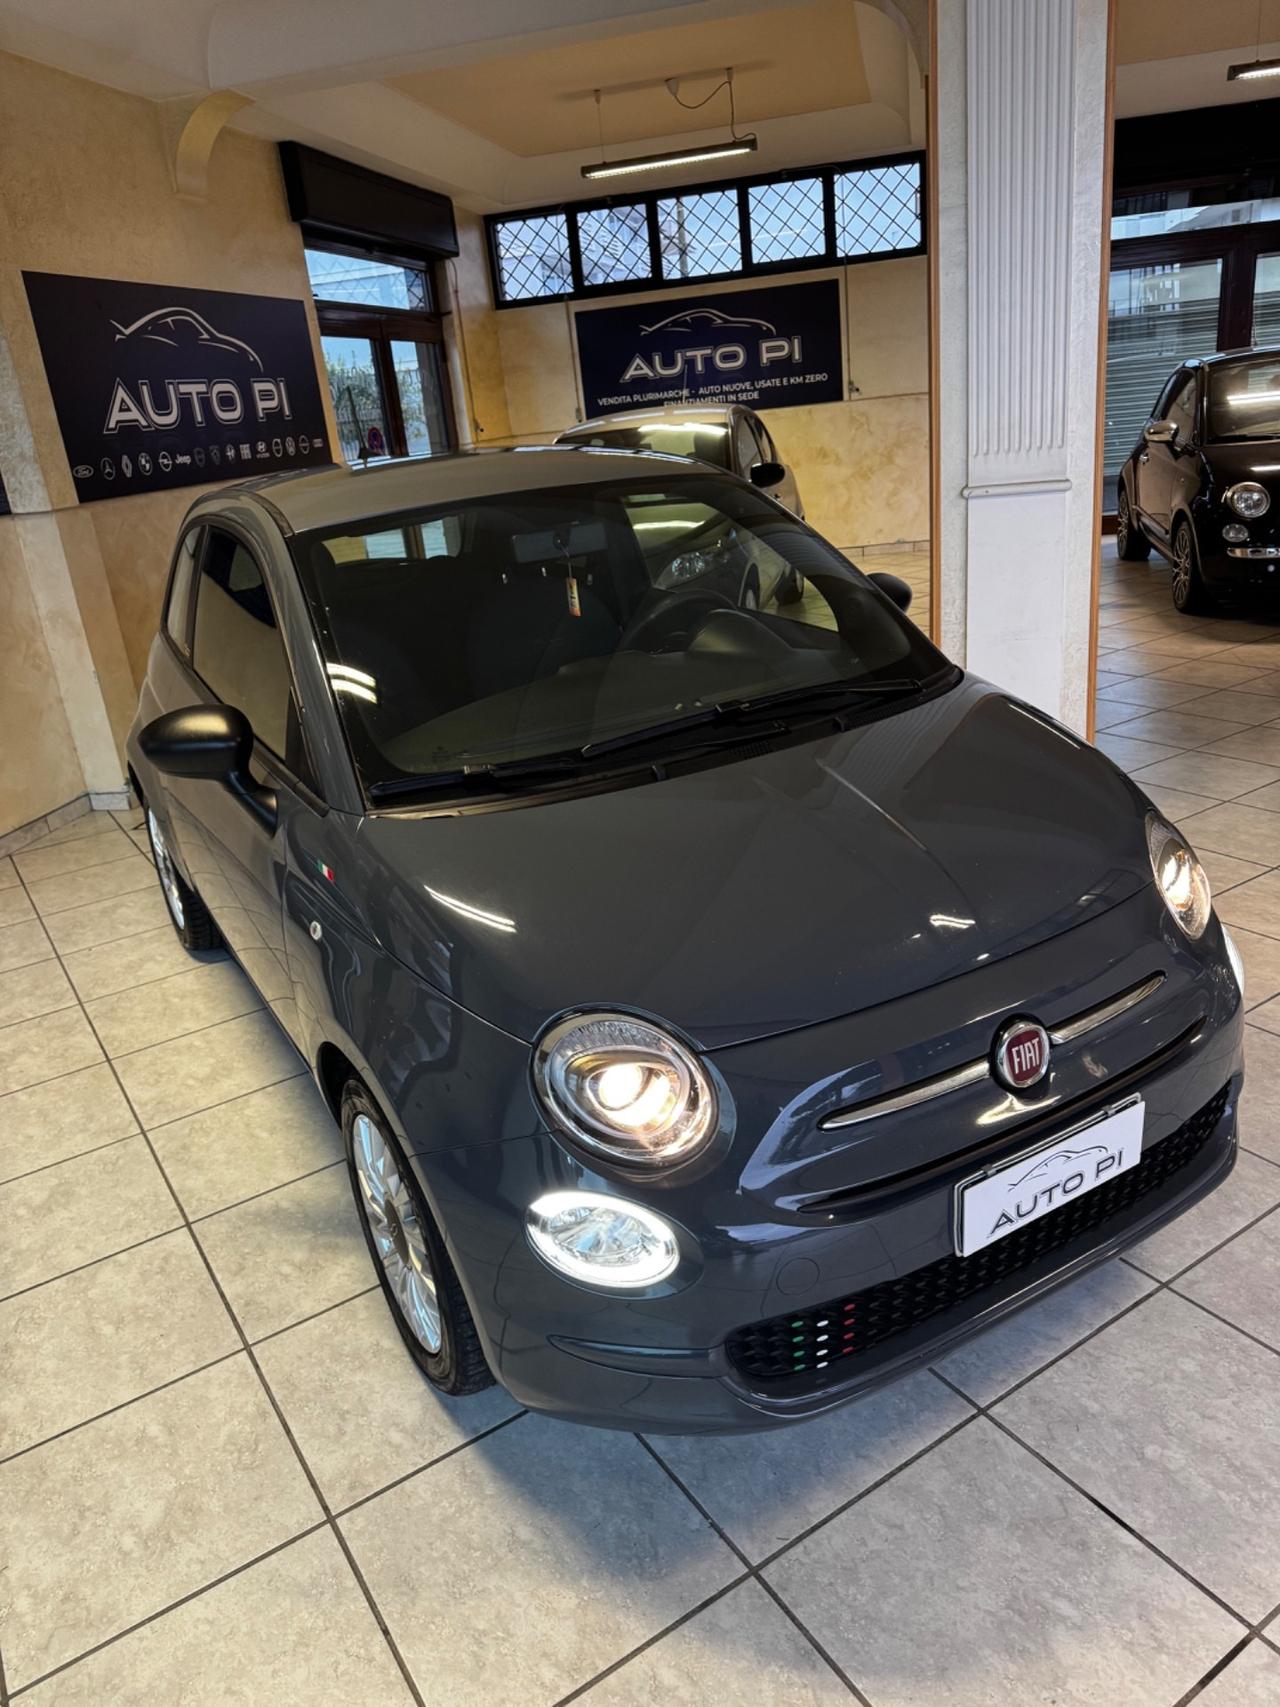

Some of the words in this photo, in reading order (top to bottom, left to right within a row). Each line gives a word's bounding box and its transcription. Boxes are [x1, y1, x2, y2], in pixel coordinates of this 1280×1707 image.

[620, 345, 747, 382] AUTO
[759, 336, 801, 367] PI
[104, 378, 244, 434] AUTO
[250, 377, 292, 422] PI
[597, 395, 632, 406] VENDITA
[633, 389, 690, 402] PLURIMARCHE
[698, 385, 721, 395] AUTO
[722, 381, 754, 392] NUOVE,
[754, 377, 782, 389] USATE
[782, 376, 789, 385] E
[790, 375, 804, 385] KM
[804, 372, 829, 383] ZERO
[727, 393, 737, 402] IN
[738, 390, 760, 402] SEDE
[1011, 1037, 1040, 1074] FIAT
[988, 1172, 1084, 1237] AUTO
[1095, 1149, 1123, 1181] PI
